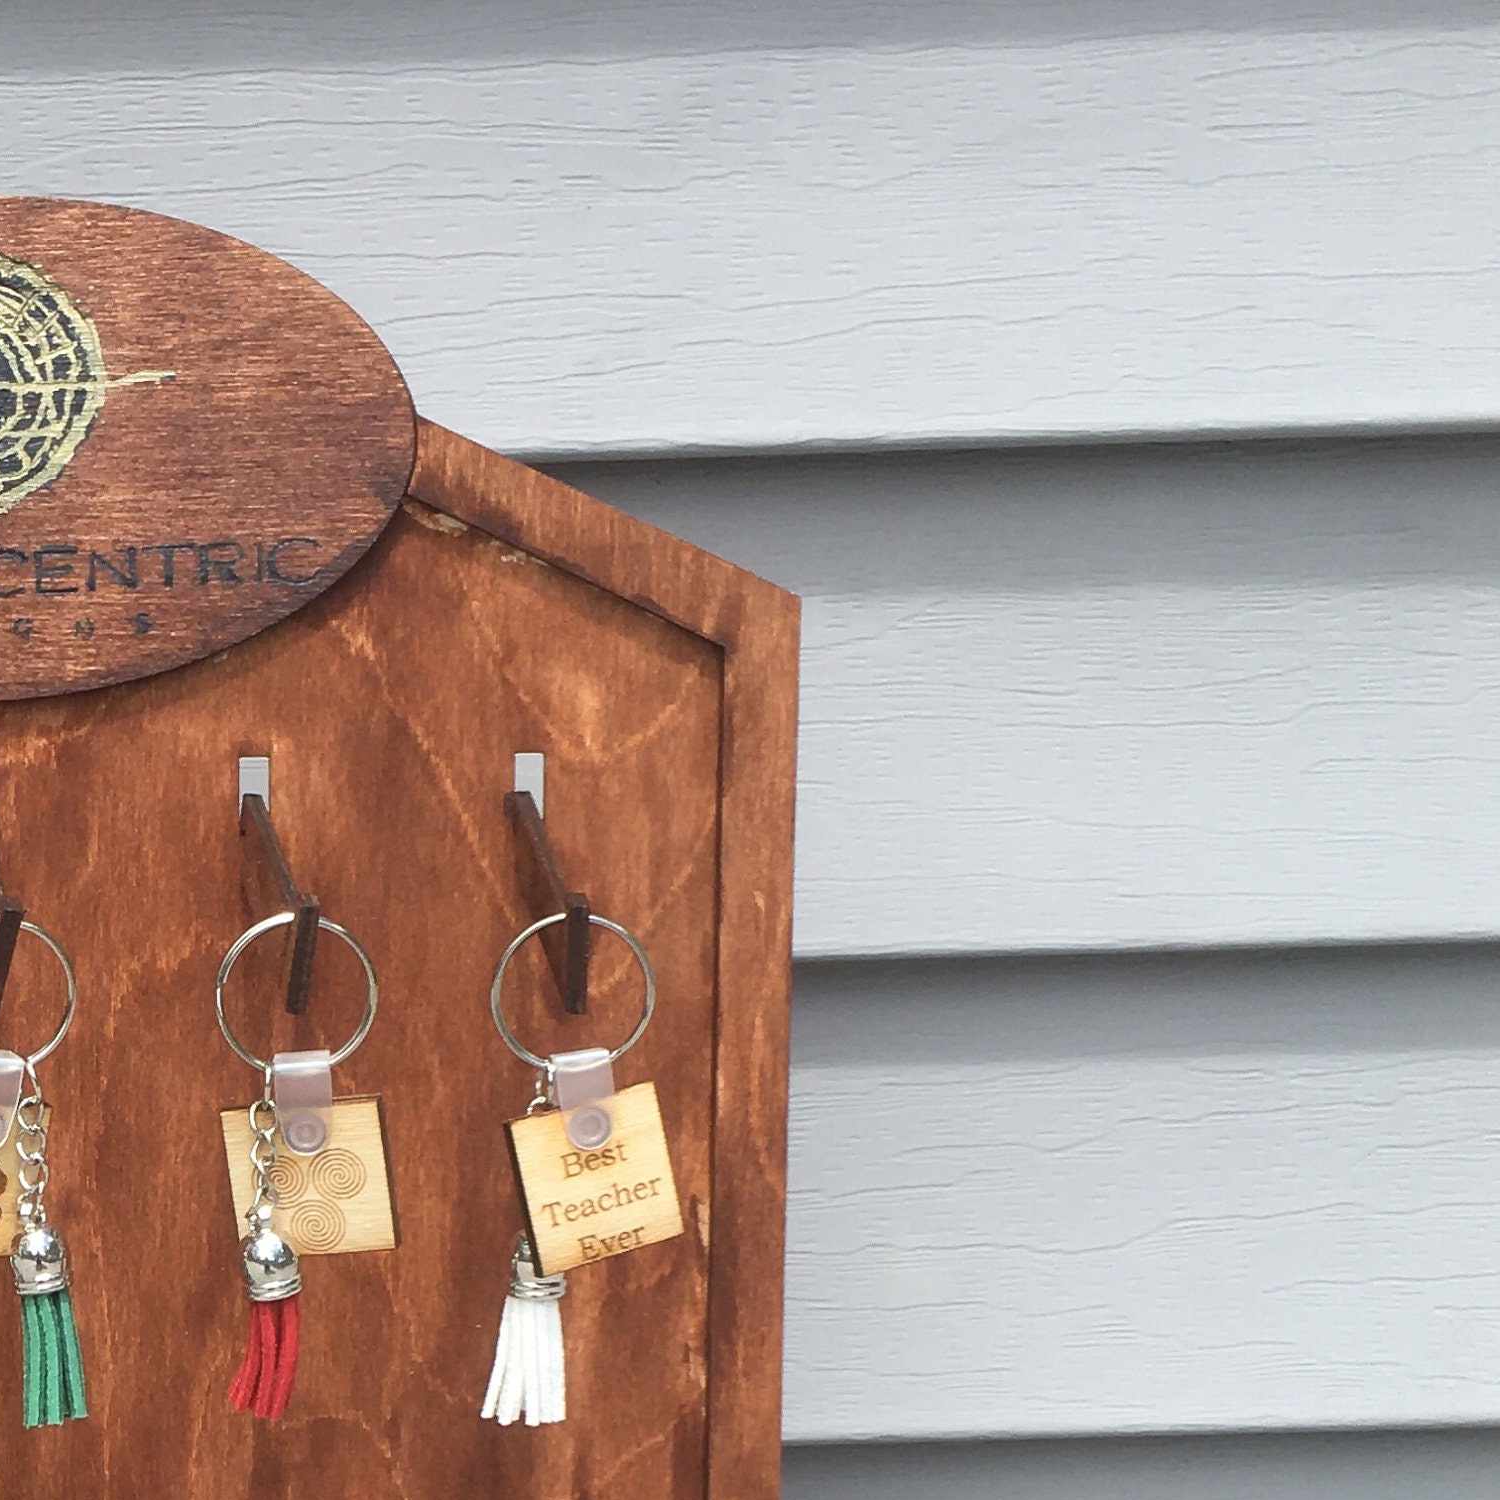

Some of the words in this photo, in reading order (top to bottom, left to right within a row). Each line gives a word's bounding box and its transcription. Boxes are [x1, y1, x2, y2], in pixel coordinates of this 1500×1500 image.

[560, 1140, 628, 1179] Best
[542, 1177, 662, 1228] Teacher
[577, 1226, 645, 1262] Ever
